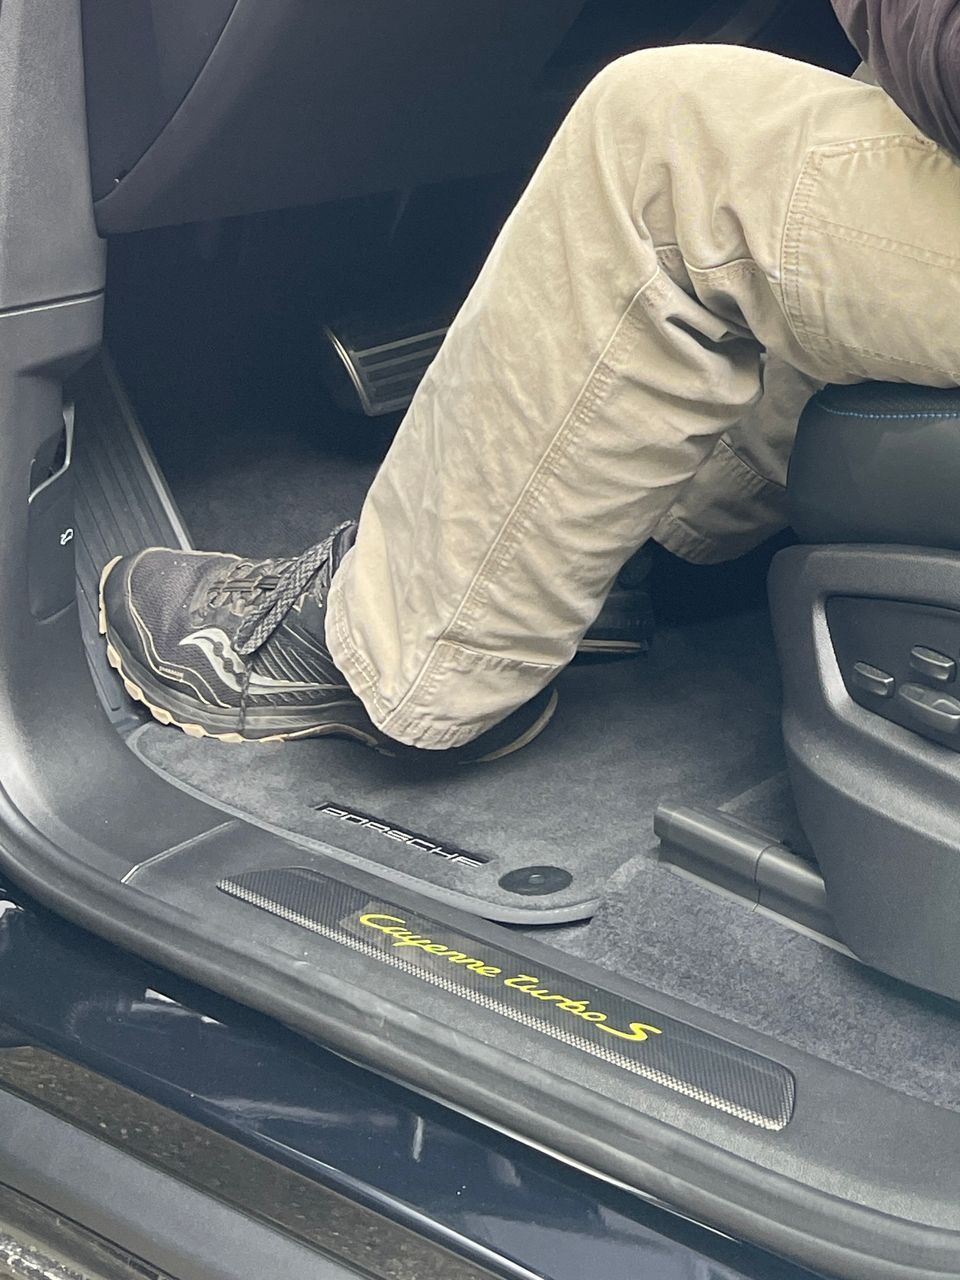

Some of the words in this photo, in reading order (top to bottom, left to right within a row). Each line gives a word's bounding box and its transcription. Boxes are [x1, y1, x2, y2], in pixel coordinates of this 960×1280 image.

[321, 806, 484, 869] PORSCHE
[359, 913, 502, 978] Cayenne
[595, 1021, 663, 1042] S
